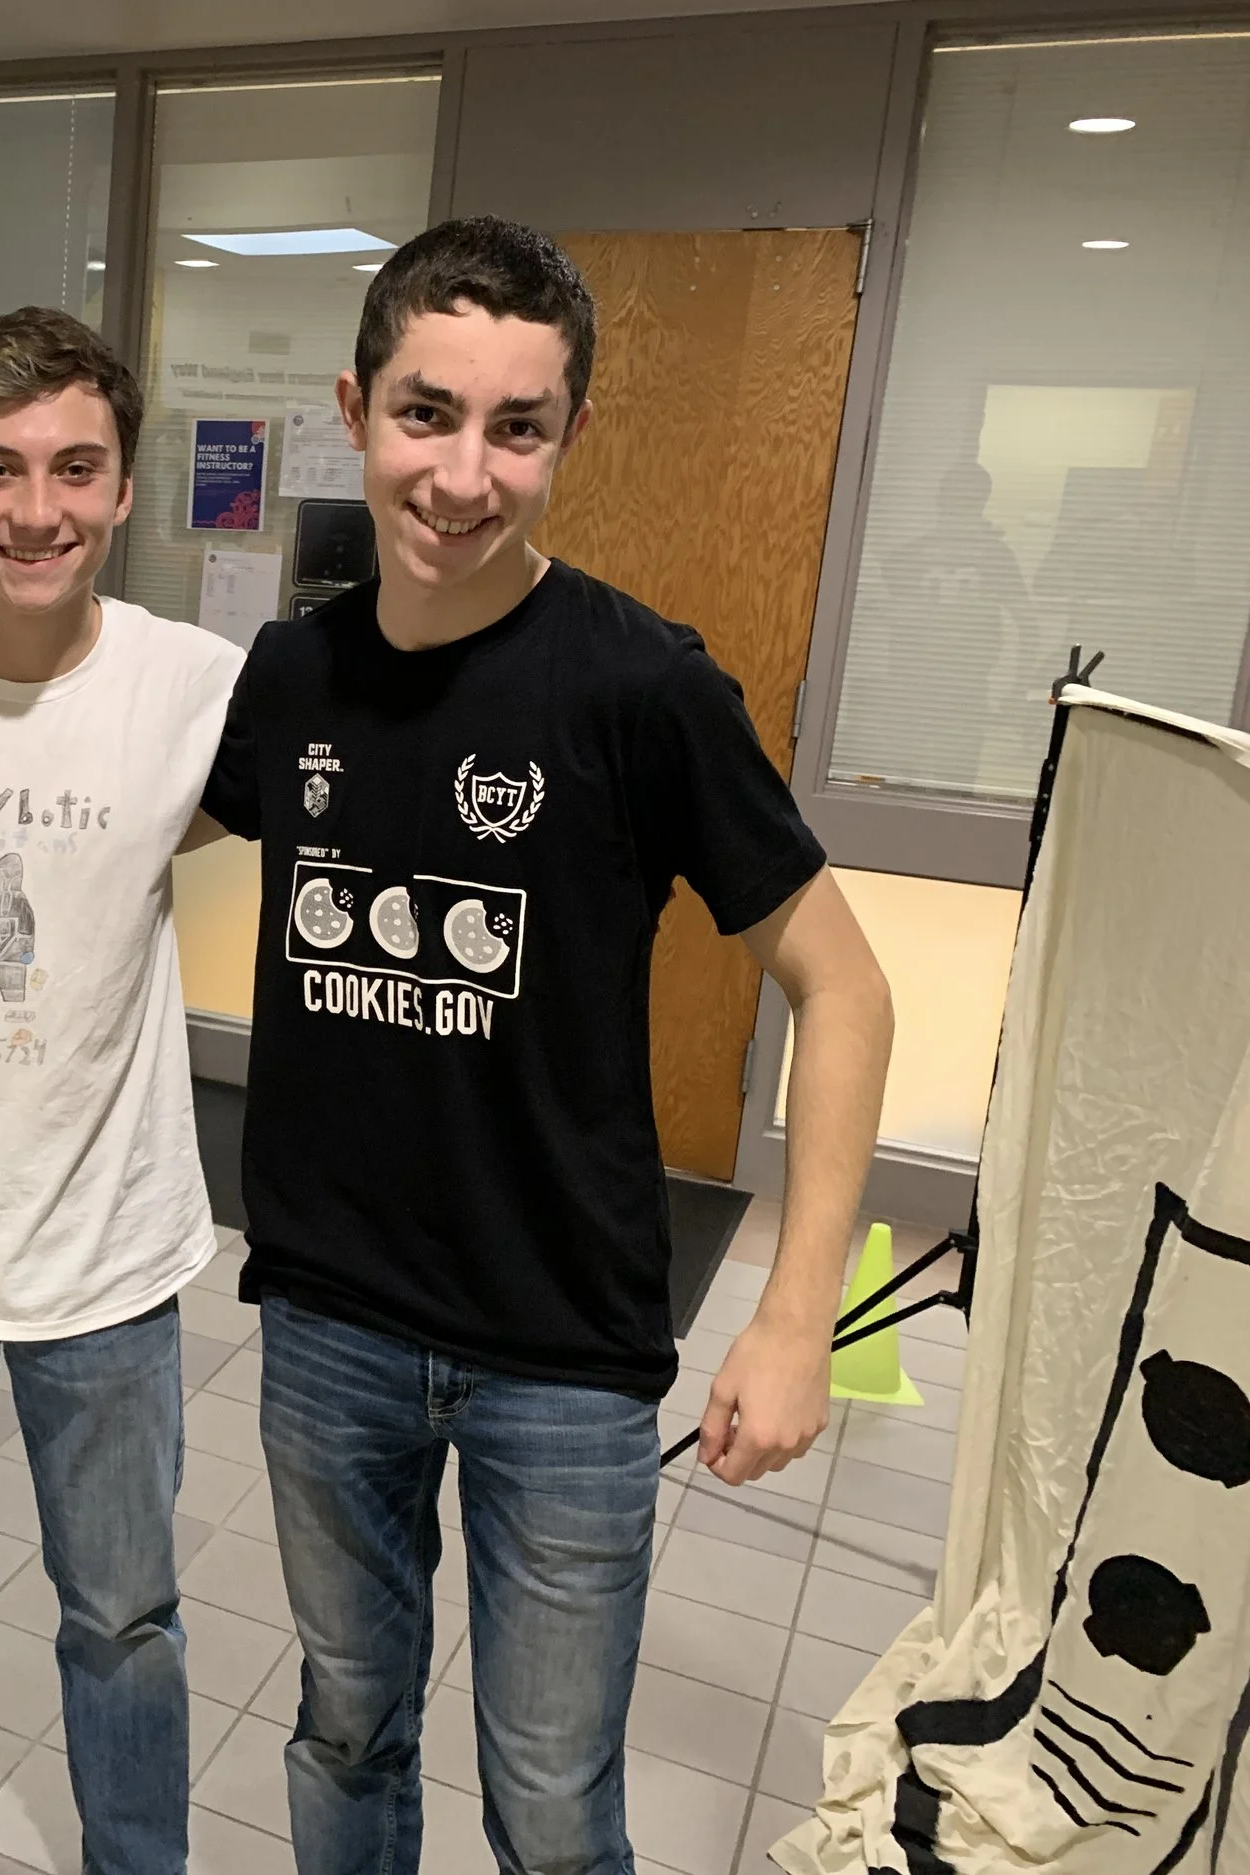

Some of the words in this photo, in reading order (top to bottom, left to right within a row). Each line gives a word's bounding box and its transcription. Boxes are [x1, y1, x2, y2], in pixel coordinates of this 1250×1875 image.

[197, 444, 223, 452] WANT
[238, 445, 248, 453] BE
[249, 445, 256, 453] A
[197, 453, 230, 461] FITNESS
[196, 462, 253, 470] INSTRUCTOR?
[308, 743, 332, 756] CITY
[477, 784, 518, 807] BCYT
[331, 848, 341, 859] BY
[303, 969, 494, 1040] COOKIES.GOV
